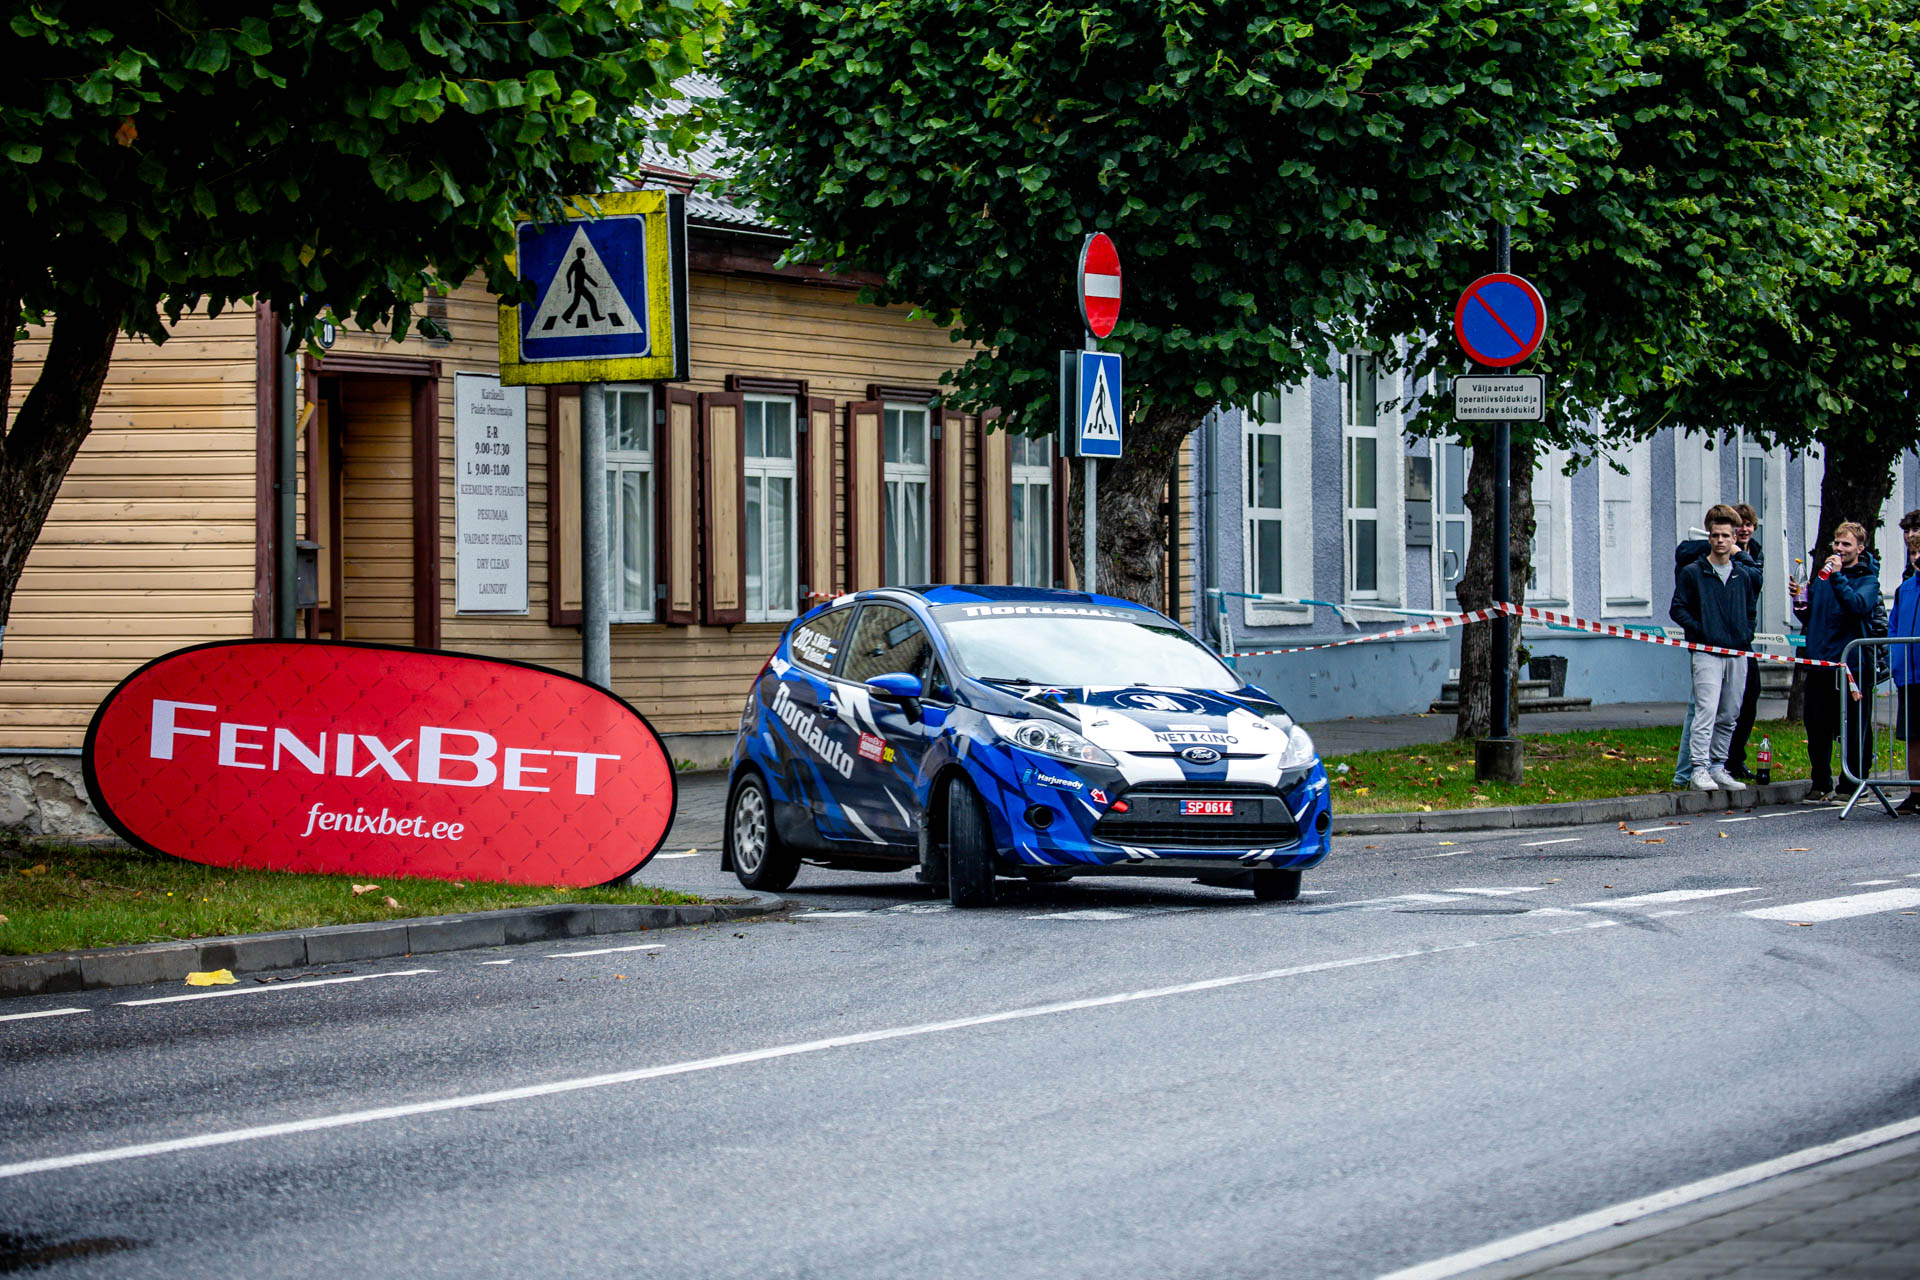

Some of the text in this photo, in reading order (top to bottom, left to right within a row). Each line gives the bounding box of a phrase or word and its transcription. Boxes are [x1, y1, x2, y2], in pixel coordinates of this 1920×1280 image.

[1472, 384, 1524, 394] Välja arvatud
[1458, 395, 1537, 404] operatiivsõidukid ja
[471, 403, 513, 418] Paide Pesumaja
[1460, 406, 1499, 414] teenindav
[487, 425, 499, 438] E-R
[467, 462, 472, 474] L
[460, 484, 525, 497] KEEMILINE PUHASTUS
[477, 508, 509, 521] PESUMAJA
[463, 533, 523, 546] VAIPADE PUHASTUS
[476, 558, 510, 570] DRY CLEAN
[478, 583, 507, 595] LAUNDRY
[1037, 773, 1084, 790] Harjuready
[1187, 802, 1232, 813] SP 0614
[300, 802, 465, 841] fenixbet.ee
